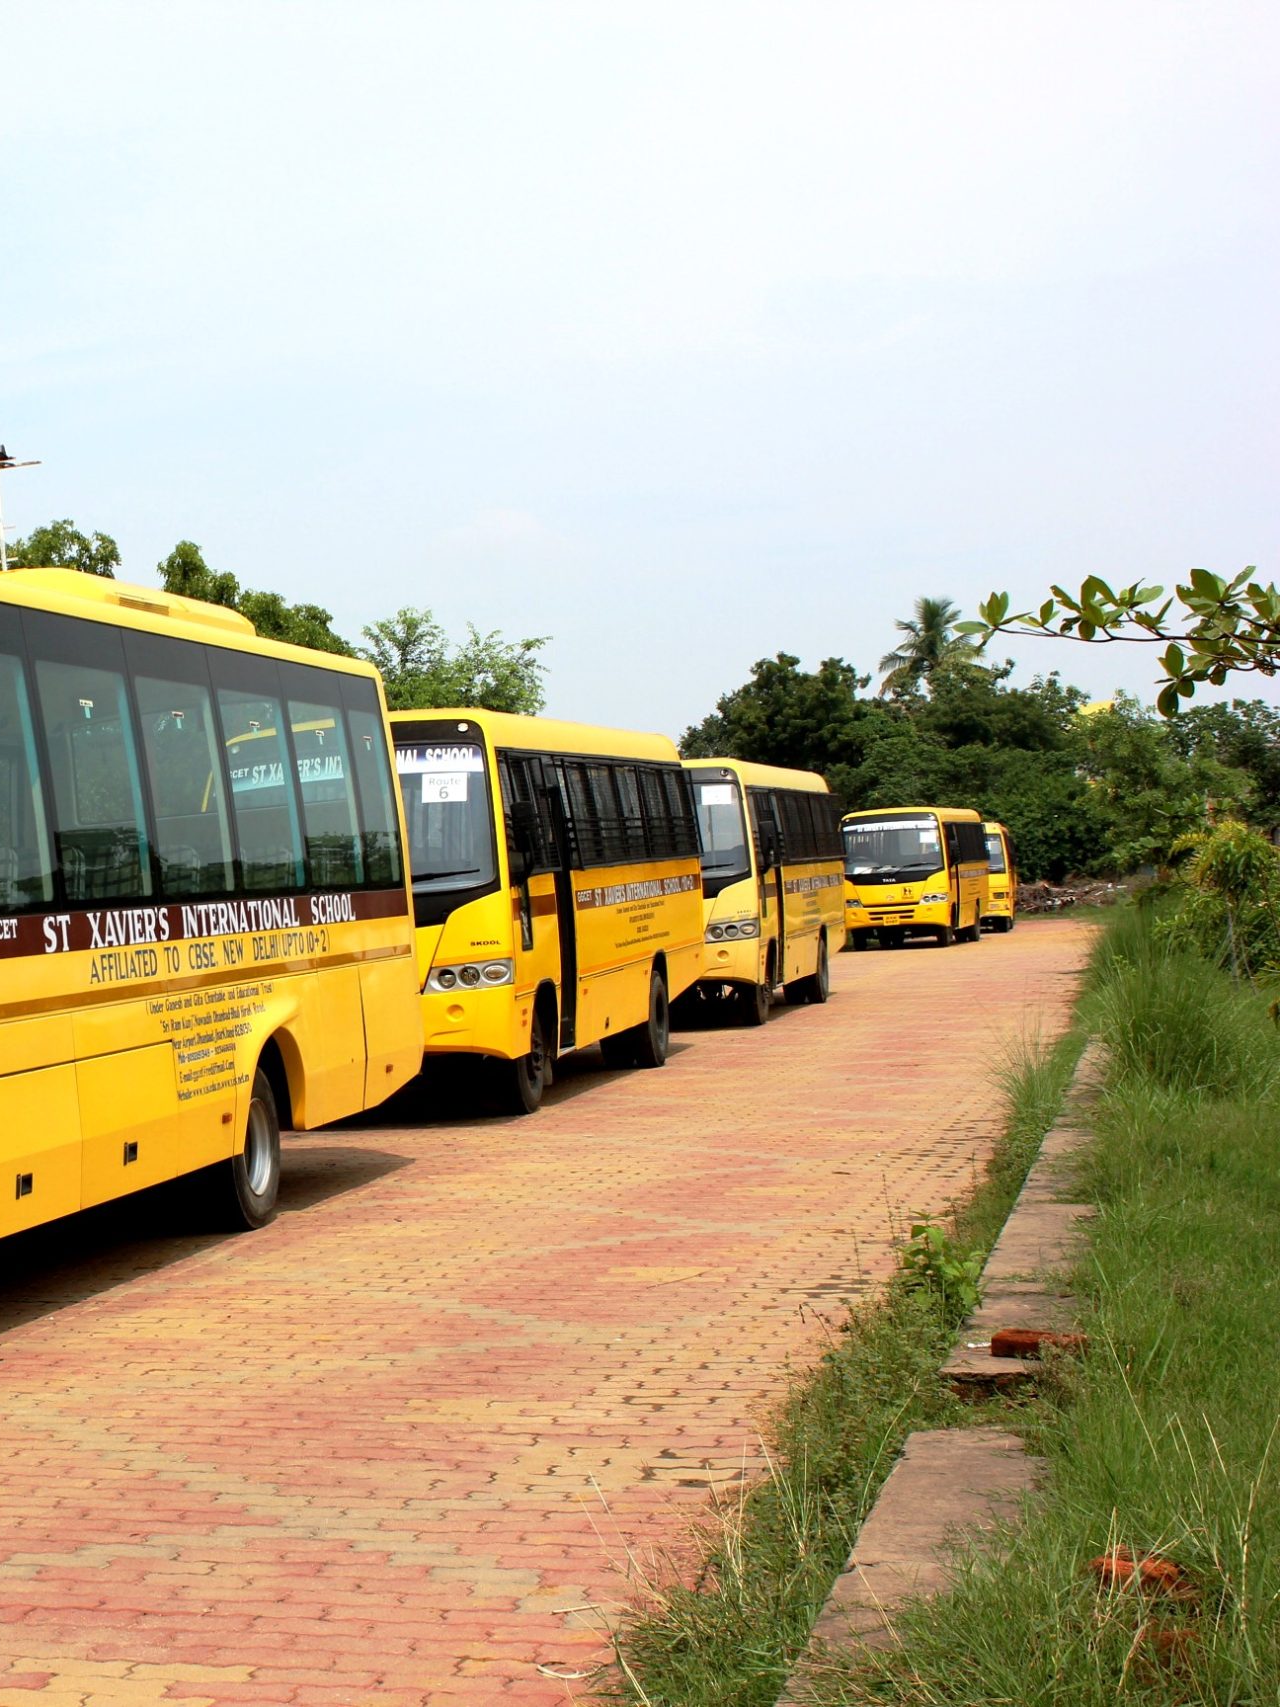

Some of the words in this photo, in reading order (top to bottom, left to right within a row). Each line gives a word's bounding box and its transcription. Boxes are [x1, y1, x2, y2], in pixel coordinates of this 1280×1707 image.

[425, 747, 473, 762] SCHOOL
[252, 763, 266, 785] ST
[429, 777, 461, 786] Route
[439, 786, 449, 799] 6
[43, 914, 71, 953] ST
[86, 907, 170, 949] XAVIER'S
[181, 898, 300, 939] INTERNATIONAL
[310, 894, 357, 925] SCHOOL
[90, 949, 158, 984] AFFILIATED
[163, 945, 180, 974] TO
[223, 938, 244, 965] NEW
[184, 995, 192, 1008] and
